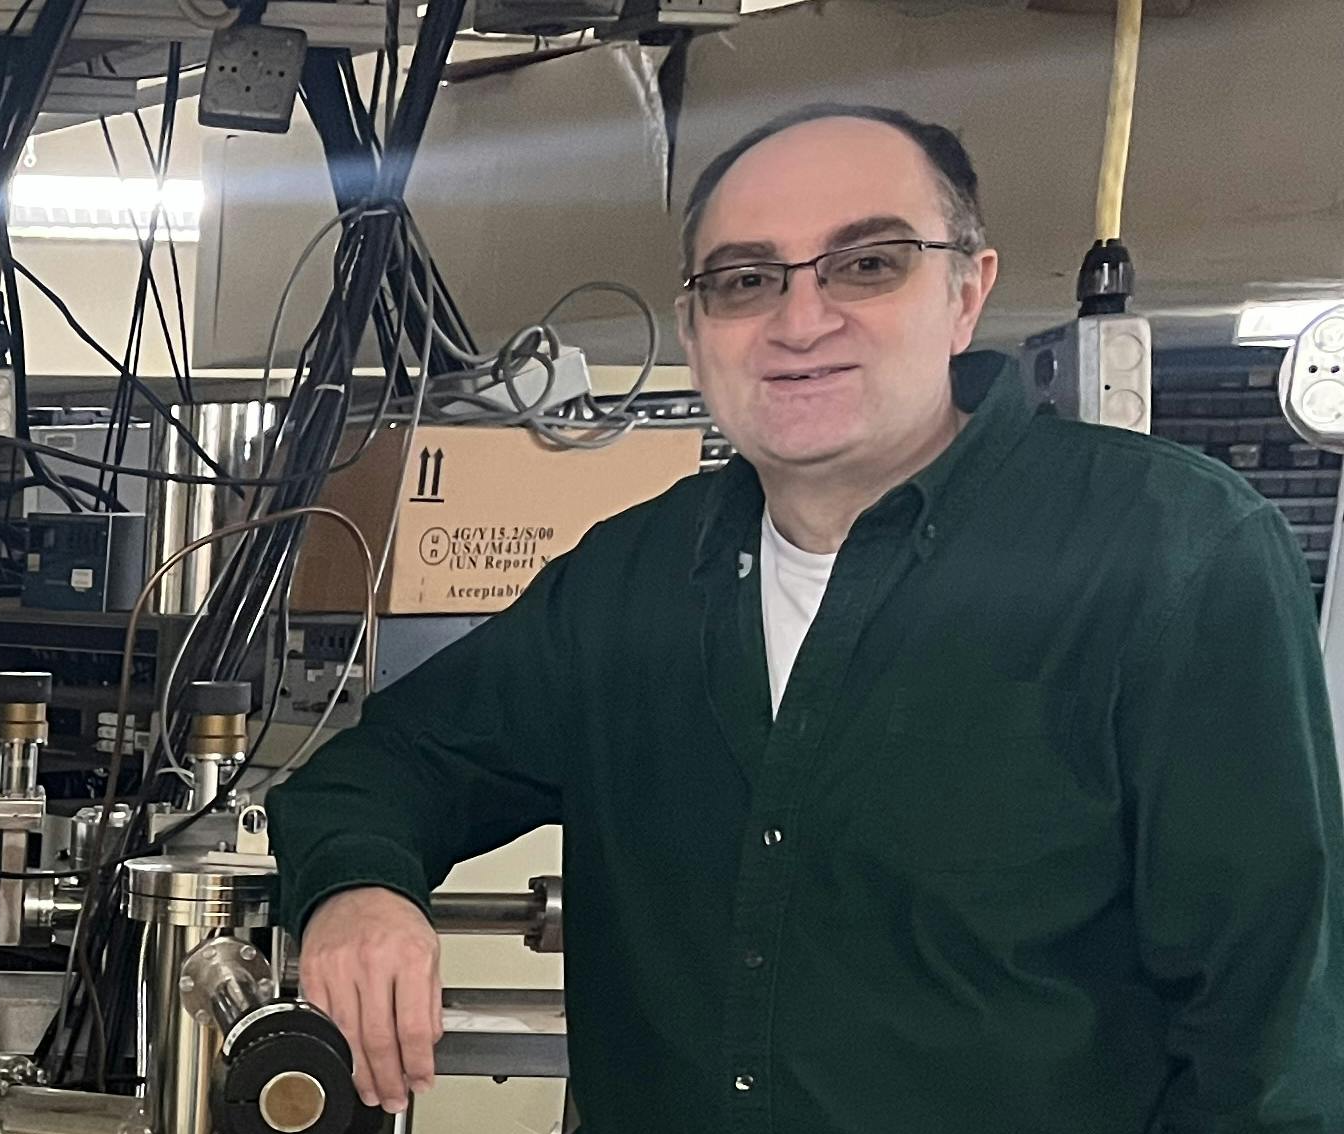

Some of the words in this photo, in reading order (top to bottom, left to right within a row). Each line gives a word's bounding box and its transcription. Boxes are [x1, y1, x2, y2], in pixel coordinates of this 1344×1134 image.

[451, 541, 536, 555] USA/M4311
[449, 555, 478, 571] (UN
[485, 555, 534, 572] Report
